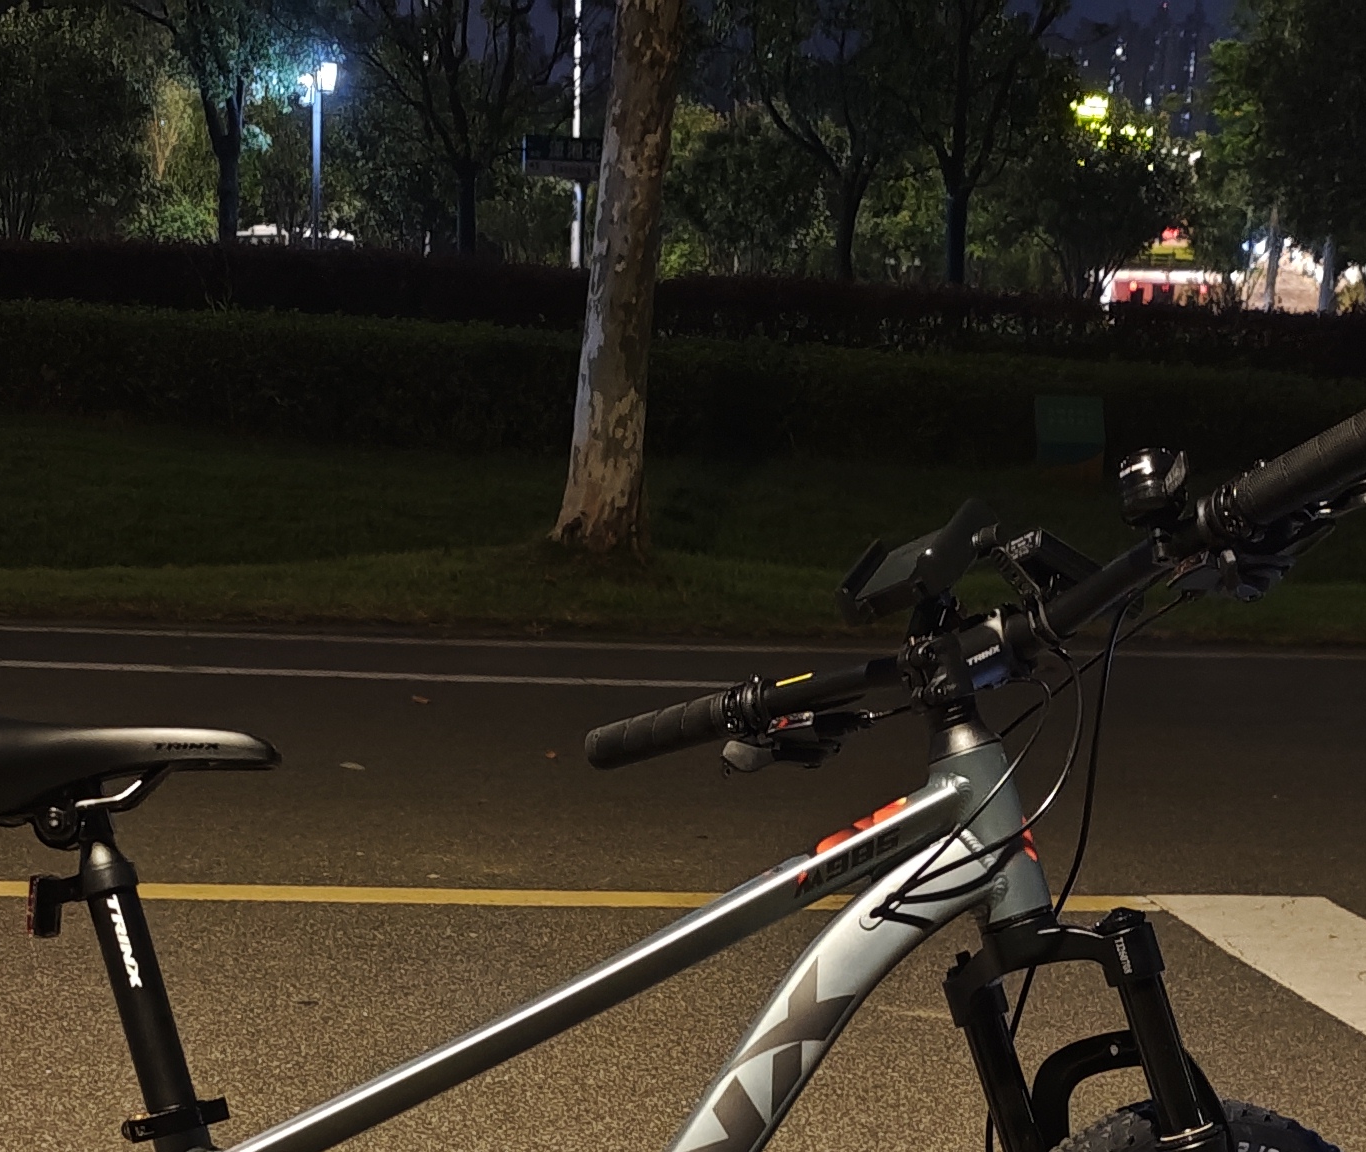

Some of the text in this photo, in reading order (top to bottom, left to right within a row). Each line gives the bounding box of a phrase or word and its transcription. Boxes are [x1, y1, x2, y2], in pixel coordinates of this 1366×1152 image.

[965, 643, 1001, 667] TRINX
[153, 741, 220, 752] TRINX
[105, 893, 144, 988] TRINX
